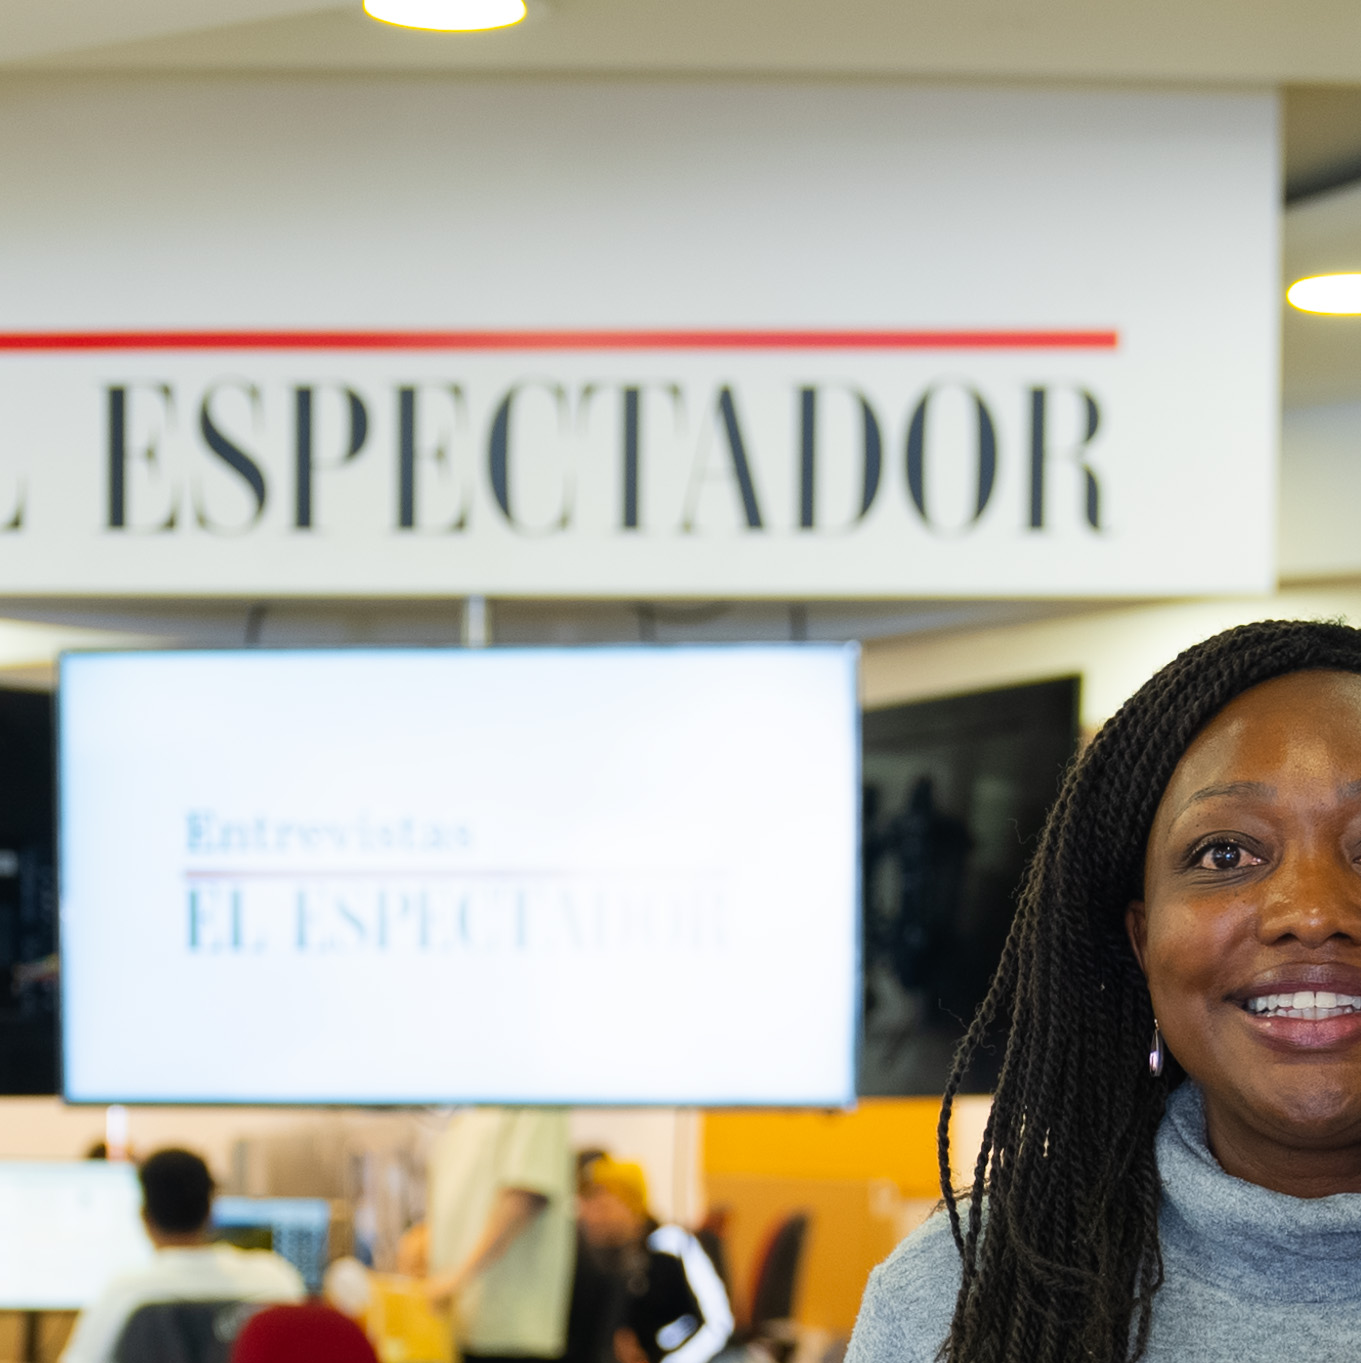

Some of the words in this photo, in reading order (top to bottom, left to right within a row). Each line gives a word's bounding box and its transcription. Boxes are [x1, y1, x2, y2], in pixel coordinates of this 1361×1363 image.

[99, 374, 1112, 539] ESPECTADOR
[185, 810, 474, 855] Entrevistas
[185, 886, 267, 954] EL
